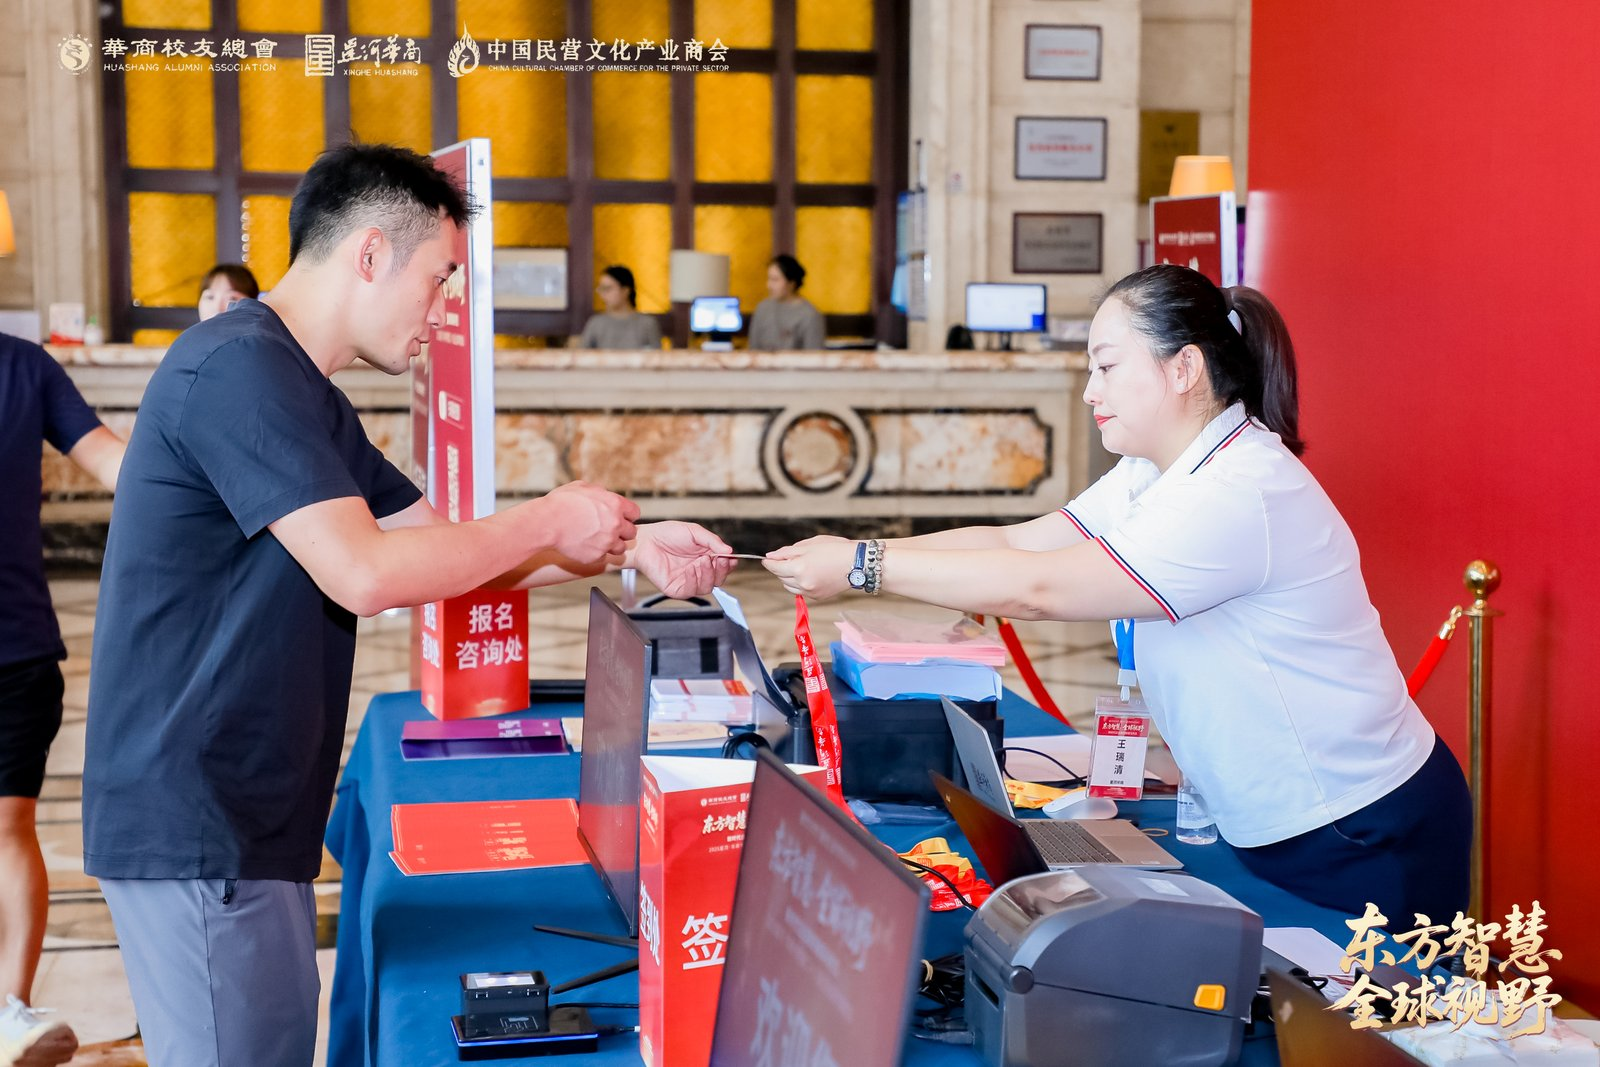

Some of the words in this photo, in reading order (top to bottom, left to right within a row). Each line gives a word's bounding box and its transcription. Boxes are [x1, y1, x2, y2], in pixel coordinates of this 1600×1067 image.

[468, 602, 514, 635] 报名
[455, 634, 524, 670] 咨询处
[1114, 739, 1126, 774] 王瑞清
